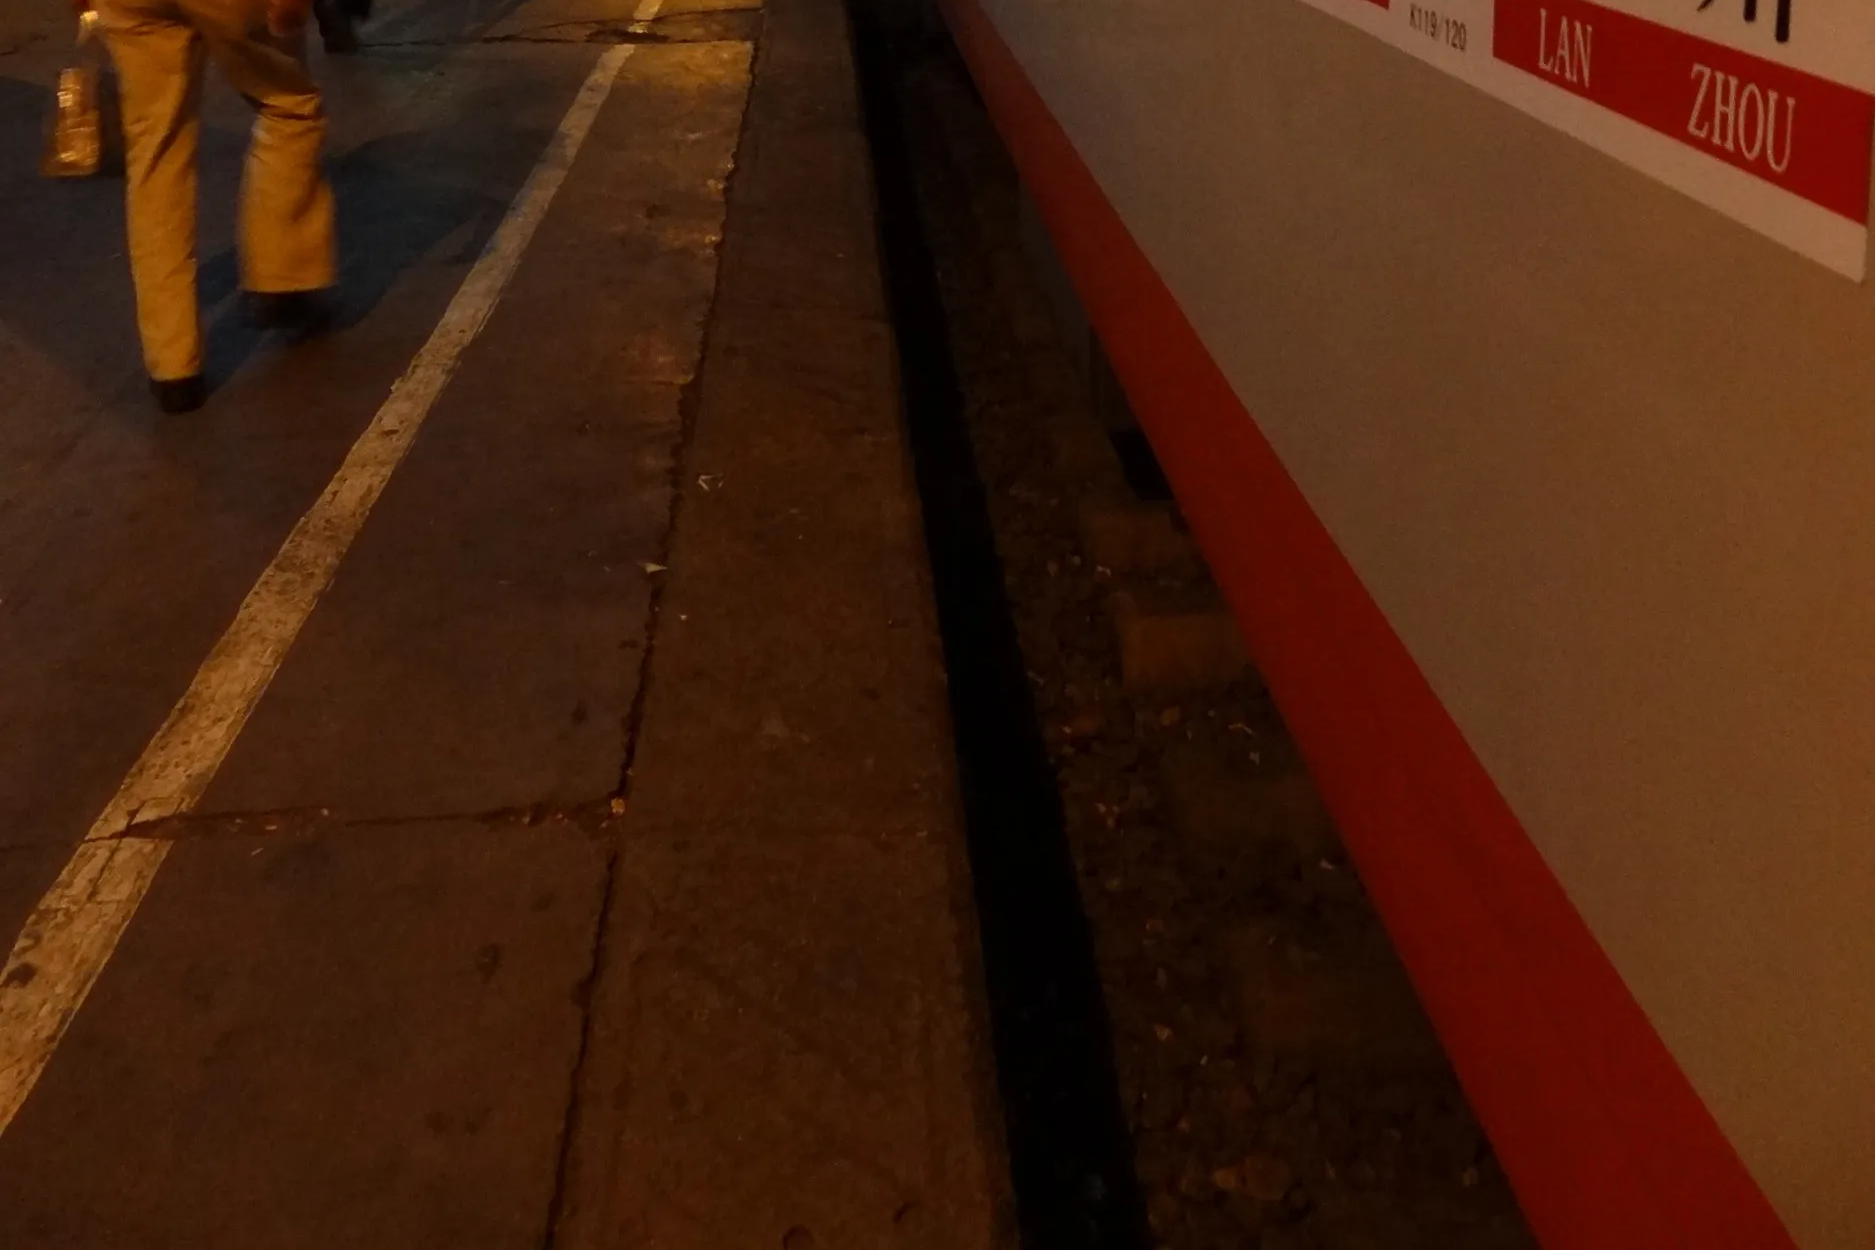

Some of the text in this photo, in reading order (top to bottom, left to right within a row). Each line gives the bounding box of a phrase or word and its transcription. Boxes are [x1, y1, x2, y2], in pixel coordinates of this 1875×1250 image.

[1409, 3, 1468, 52] K119/120
[1538, 8, 1593, 89] LAN
[1687, 63, 1797, 173] ZHOU
